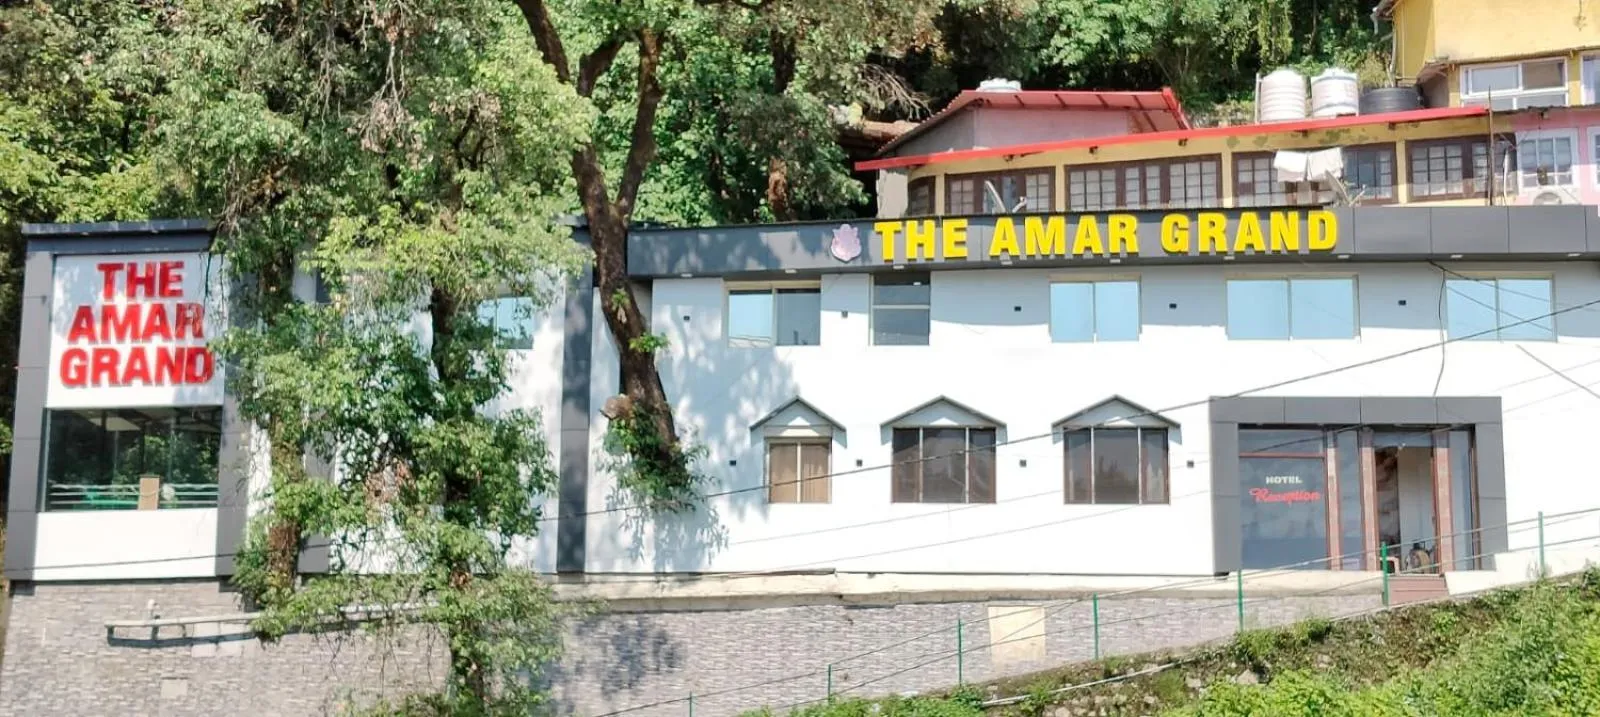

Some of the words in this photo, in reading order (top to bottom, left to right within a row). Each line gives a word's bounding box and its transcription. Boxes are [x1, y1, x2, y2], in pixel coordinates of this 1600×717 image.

[874, 216, 968, 262] THE
[988, 210, 1139, 257] AMAR
[1160, 208, 1339, 254] GRAND
[97, 260, 185, 300] THE
[67, 303, 206, 345] AMAR
[59, 347, 215, 388] GRAND
[1249, 487, 1321, 505] Reception
[1265, 475, 1303, 485] HOTEL
